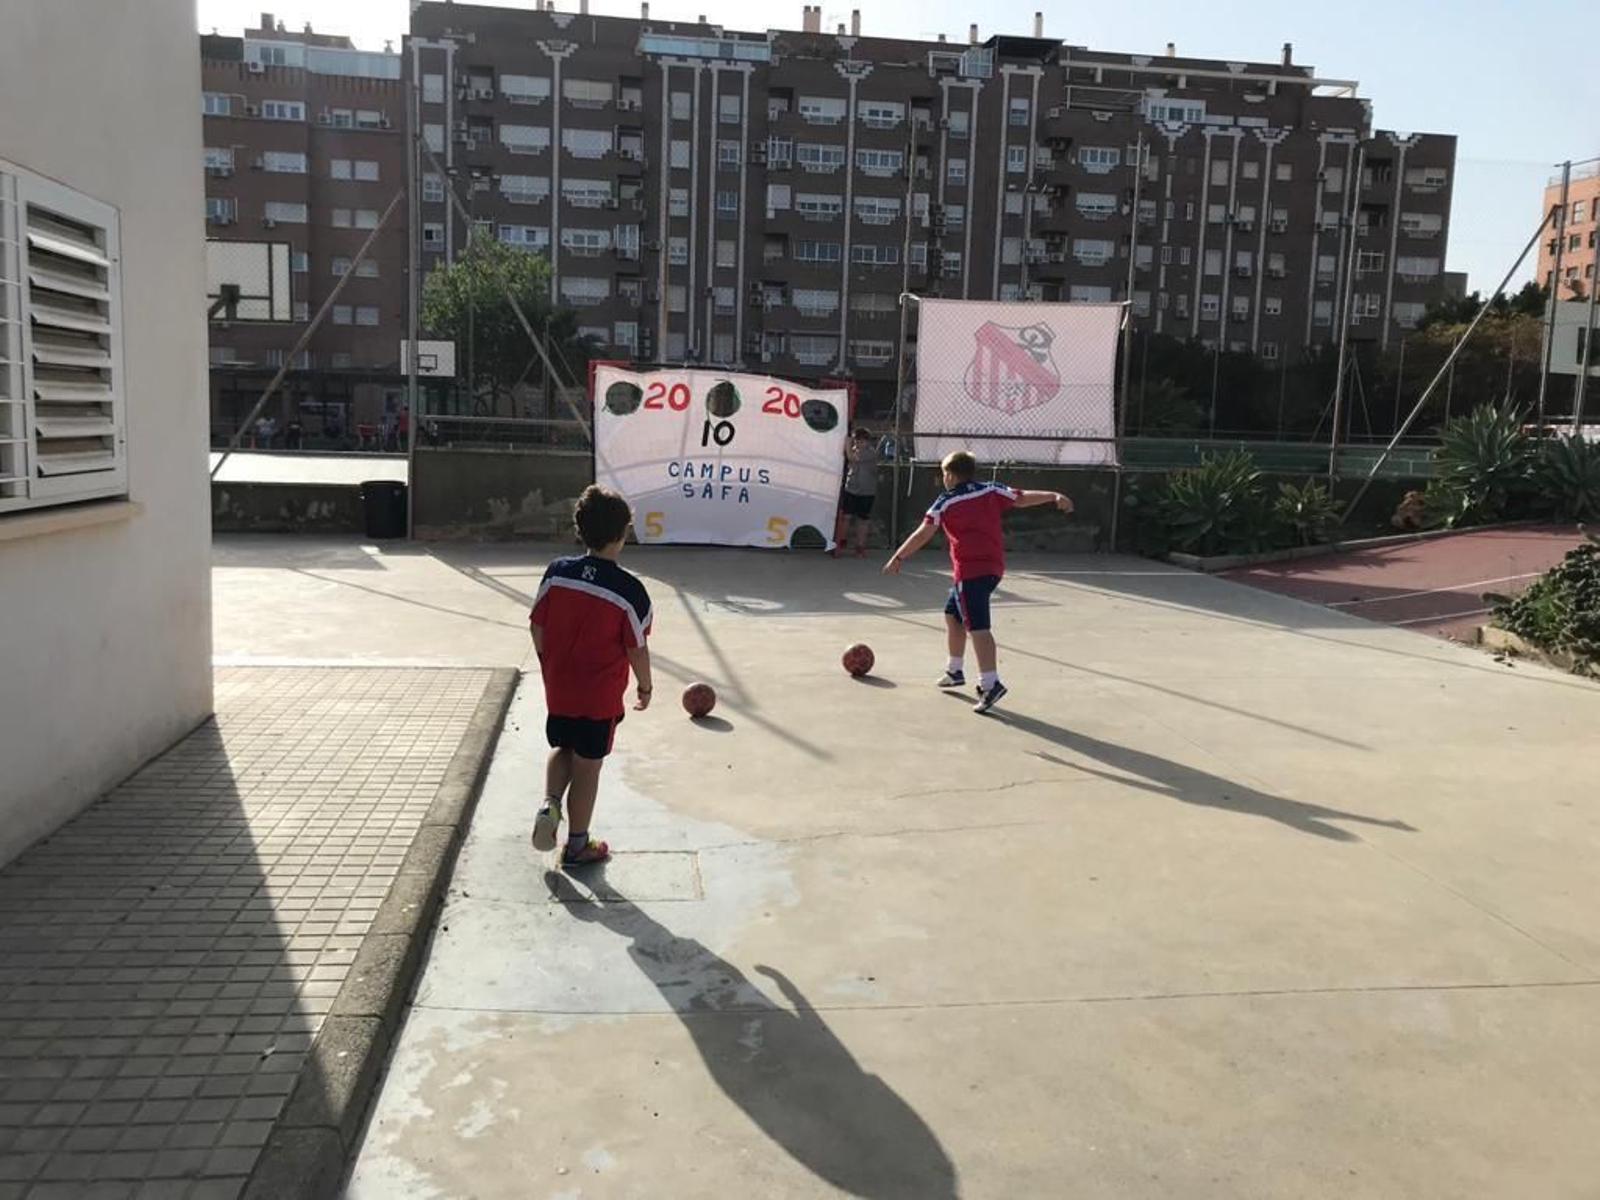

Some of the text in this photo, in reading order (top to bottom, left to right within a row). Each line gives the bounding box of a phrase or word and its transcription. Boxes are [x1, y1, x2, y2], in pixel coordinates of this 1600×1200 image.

[644, 382, 691, 411] 20
[762, 386, 801, 418] 20
[701, 419, 736, 447] 10
[668, 461, 770, 484] CAMPUS
[683, 483, 750, 503] SAFA
[644, 511, 665, 538] 5
[766, 516, 789, 543] 5
